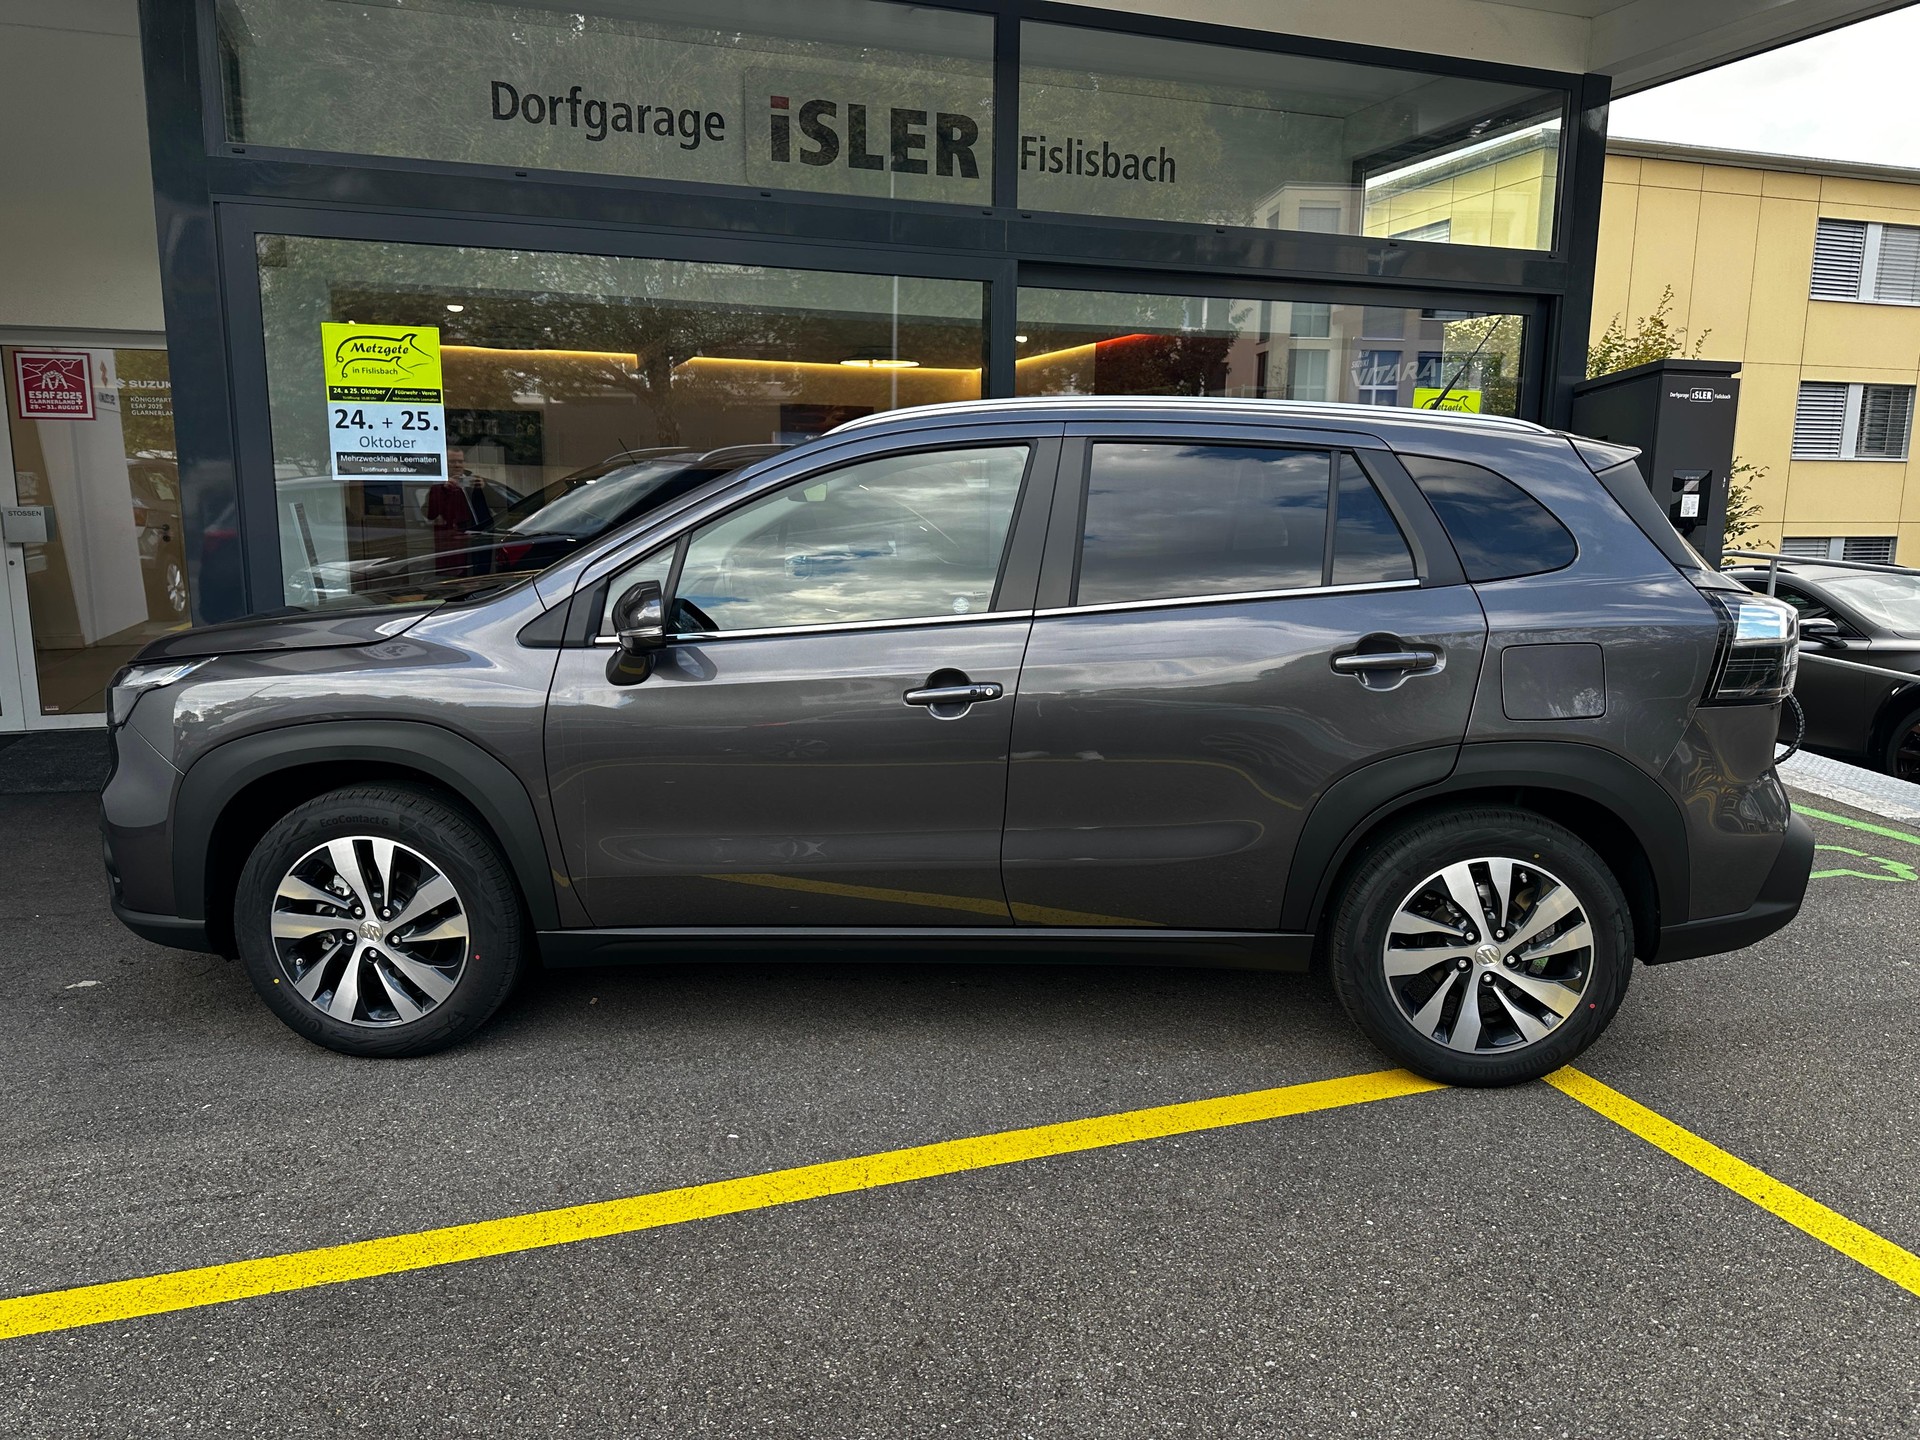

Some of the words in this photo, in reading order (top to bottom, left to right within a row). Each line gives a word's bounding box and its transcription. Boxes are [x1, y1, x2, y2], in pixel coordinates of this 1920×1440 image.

[490, 80, 725, 150] Dorfgarage
[770, 95, 980, 179] iSLER
[1020, 135, 1176, 184] Fislisbach
[350, 342, 409, 357] Metzgete
[361, 367, 398, 375] Fislisbach
[1351, 358, 1437, 388] VITARA
[28, 391, 56, 399] ESAF
[56, 391, 83, 400] 2025
[334, 408, 374, 430] 24.
[381, 417, 393, 429] +
[400, 410, 439, 431] 25.
[359, 435, 417, 449] Oktober
[340, 454, 398, 463] Mehrzweckhalle
[399, 455, 438, 464] Leematten
[319, 814, 380, 828] EcoContact
[381, 817, 389, 826] 6
